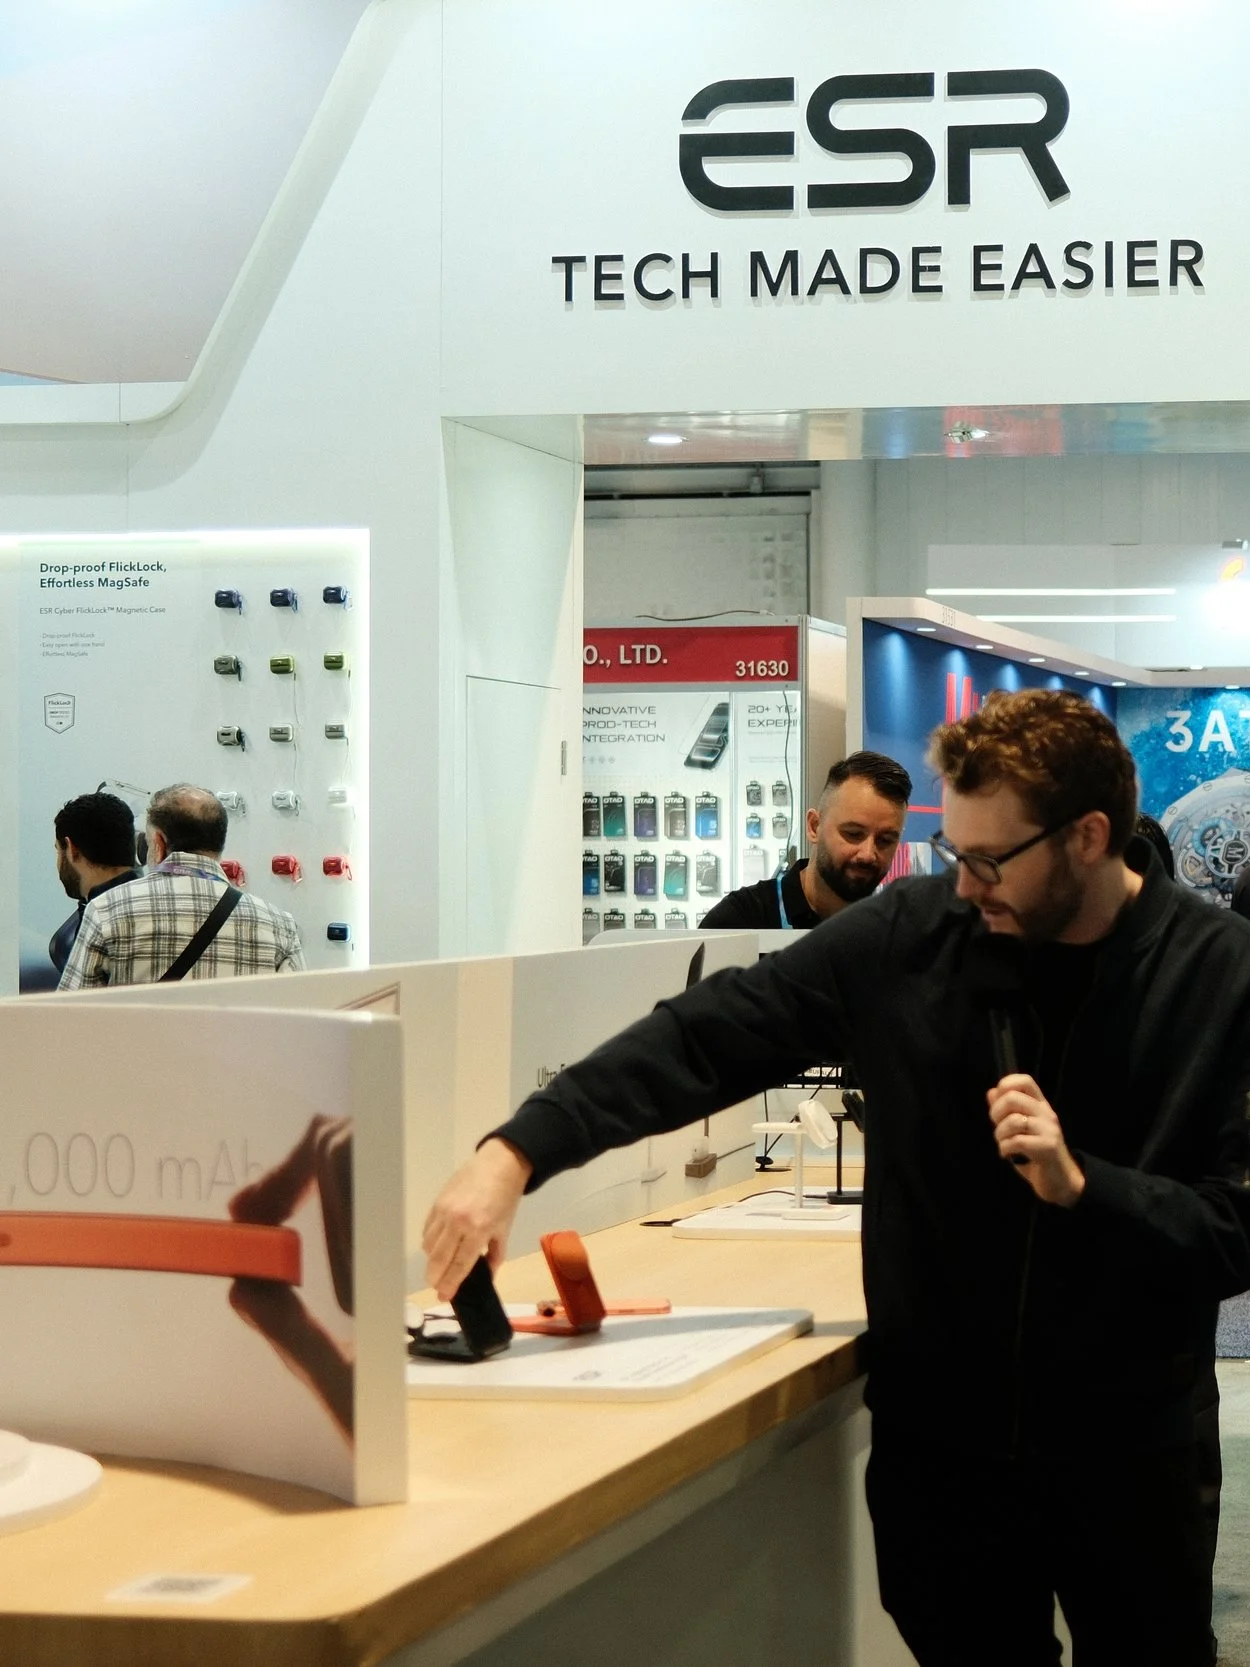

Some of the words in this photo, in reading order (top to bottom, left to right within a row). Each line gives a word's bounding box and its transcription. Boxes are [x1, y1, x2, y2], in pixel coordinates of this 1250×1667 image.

[679, 68, 1071, 212] ESR
[551, 251, 720, 302] TECH
[749, 245, 944, 297] MADE
[971, 239, 1205, 292] EASIER
[39, 561, 106, 575] Drop-proof
[109, 560, 167, 573] FlickLock,
[40, 578, 95, 588] Effortless
[97, 576, 150, 590] MagSafe
[39, 607, 53, 615] ESR
[54, 607, 75, 615] Cyber
[116, 606, 148, 615] Magnetic
[149, 606, 167, 614] Case
[620, 644, 668, 664] LTD.
[735, 660, 789, 677] 31630
[747, 704, 772, 714] 20+
[747, 719, 797, 728] EXPERI
